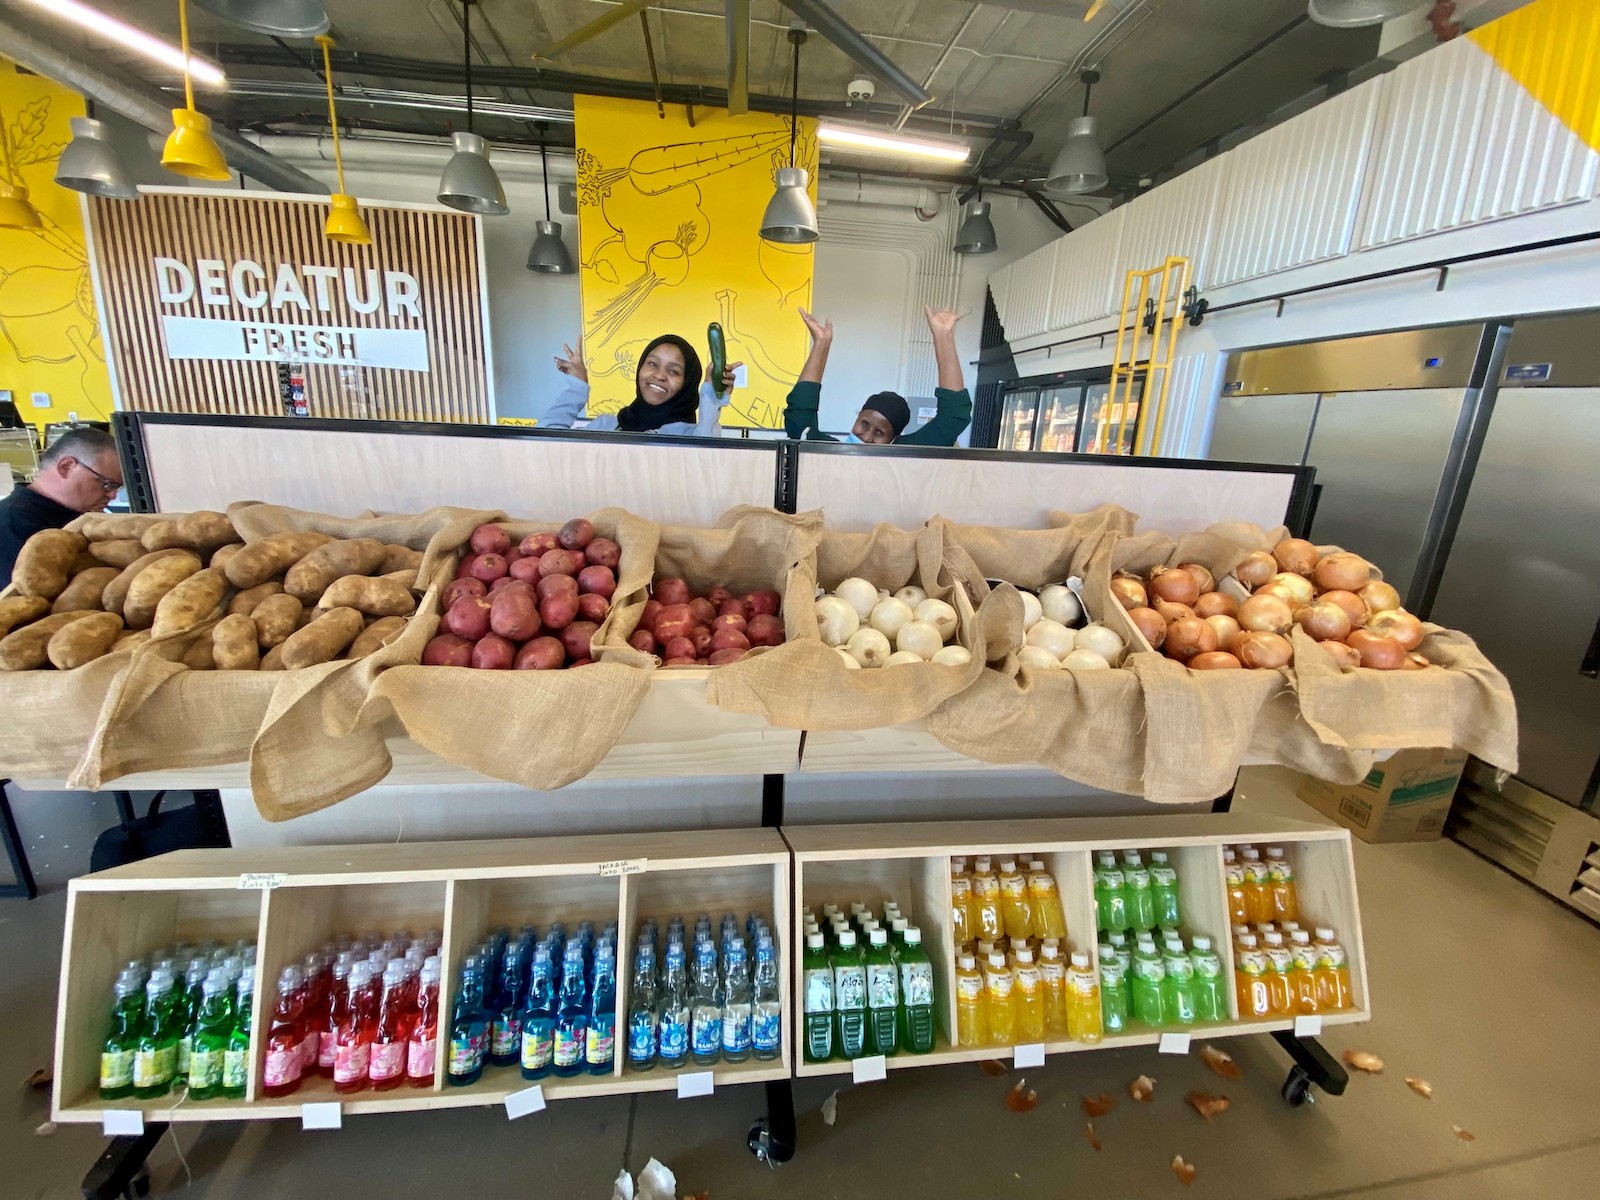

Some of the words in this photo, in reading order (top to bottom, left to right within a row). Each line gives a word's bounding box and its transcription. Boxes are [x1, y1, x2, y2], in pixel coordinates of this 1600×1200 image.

[154, 257, 421, 317] DECATUR
[242, 327, 358, 359] FRESH
[747, 397, 786, 429] EN
